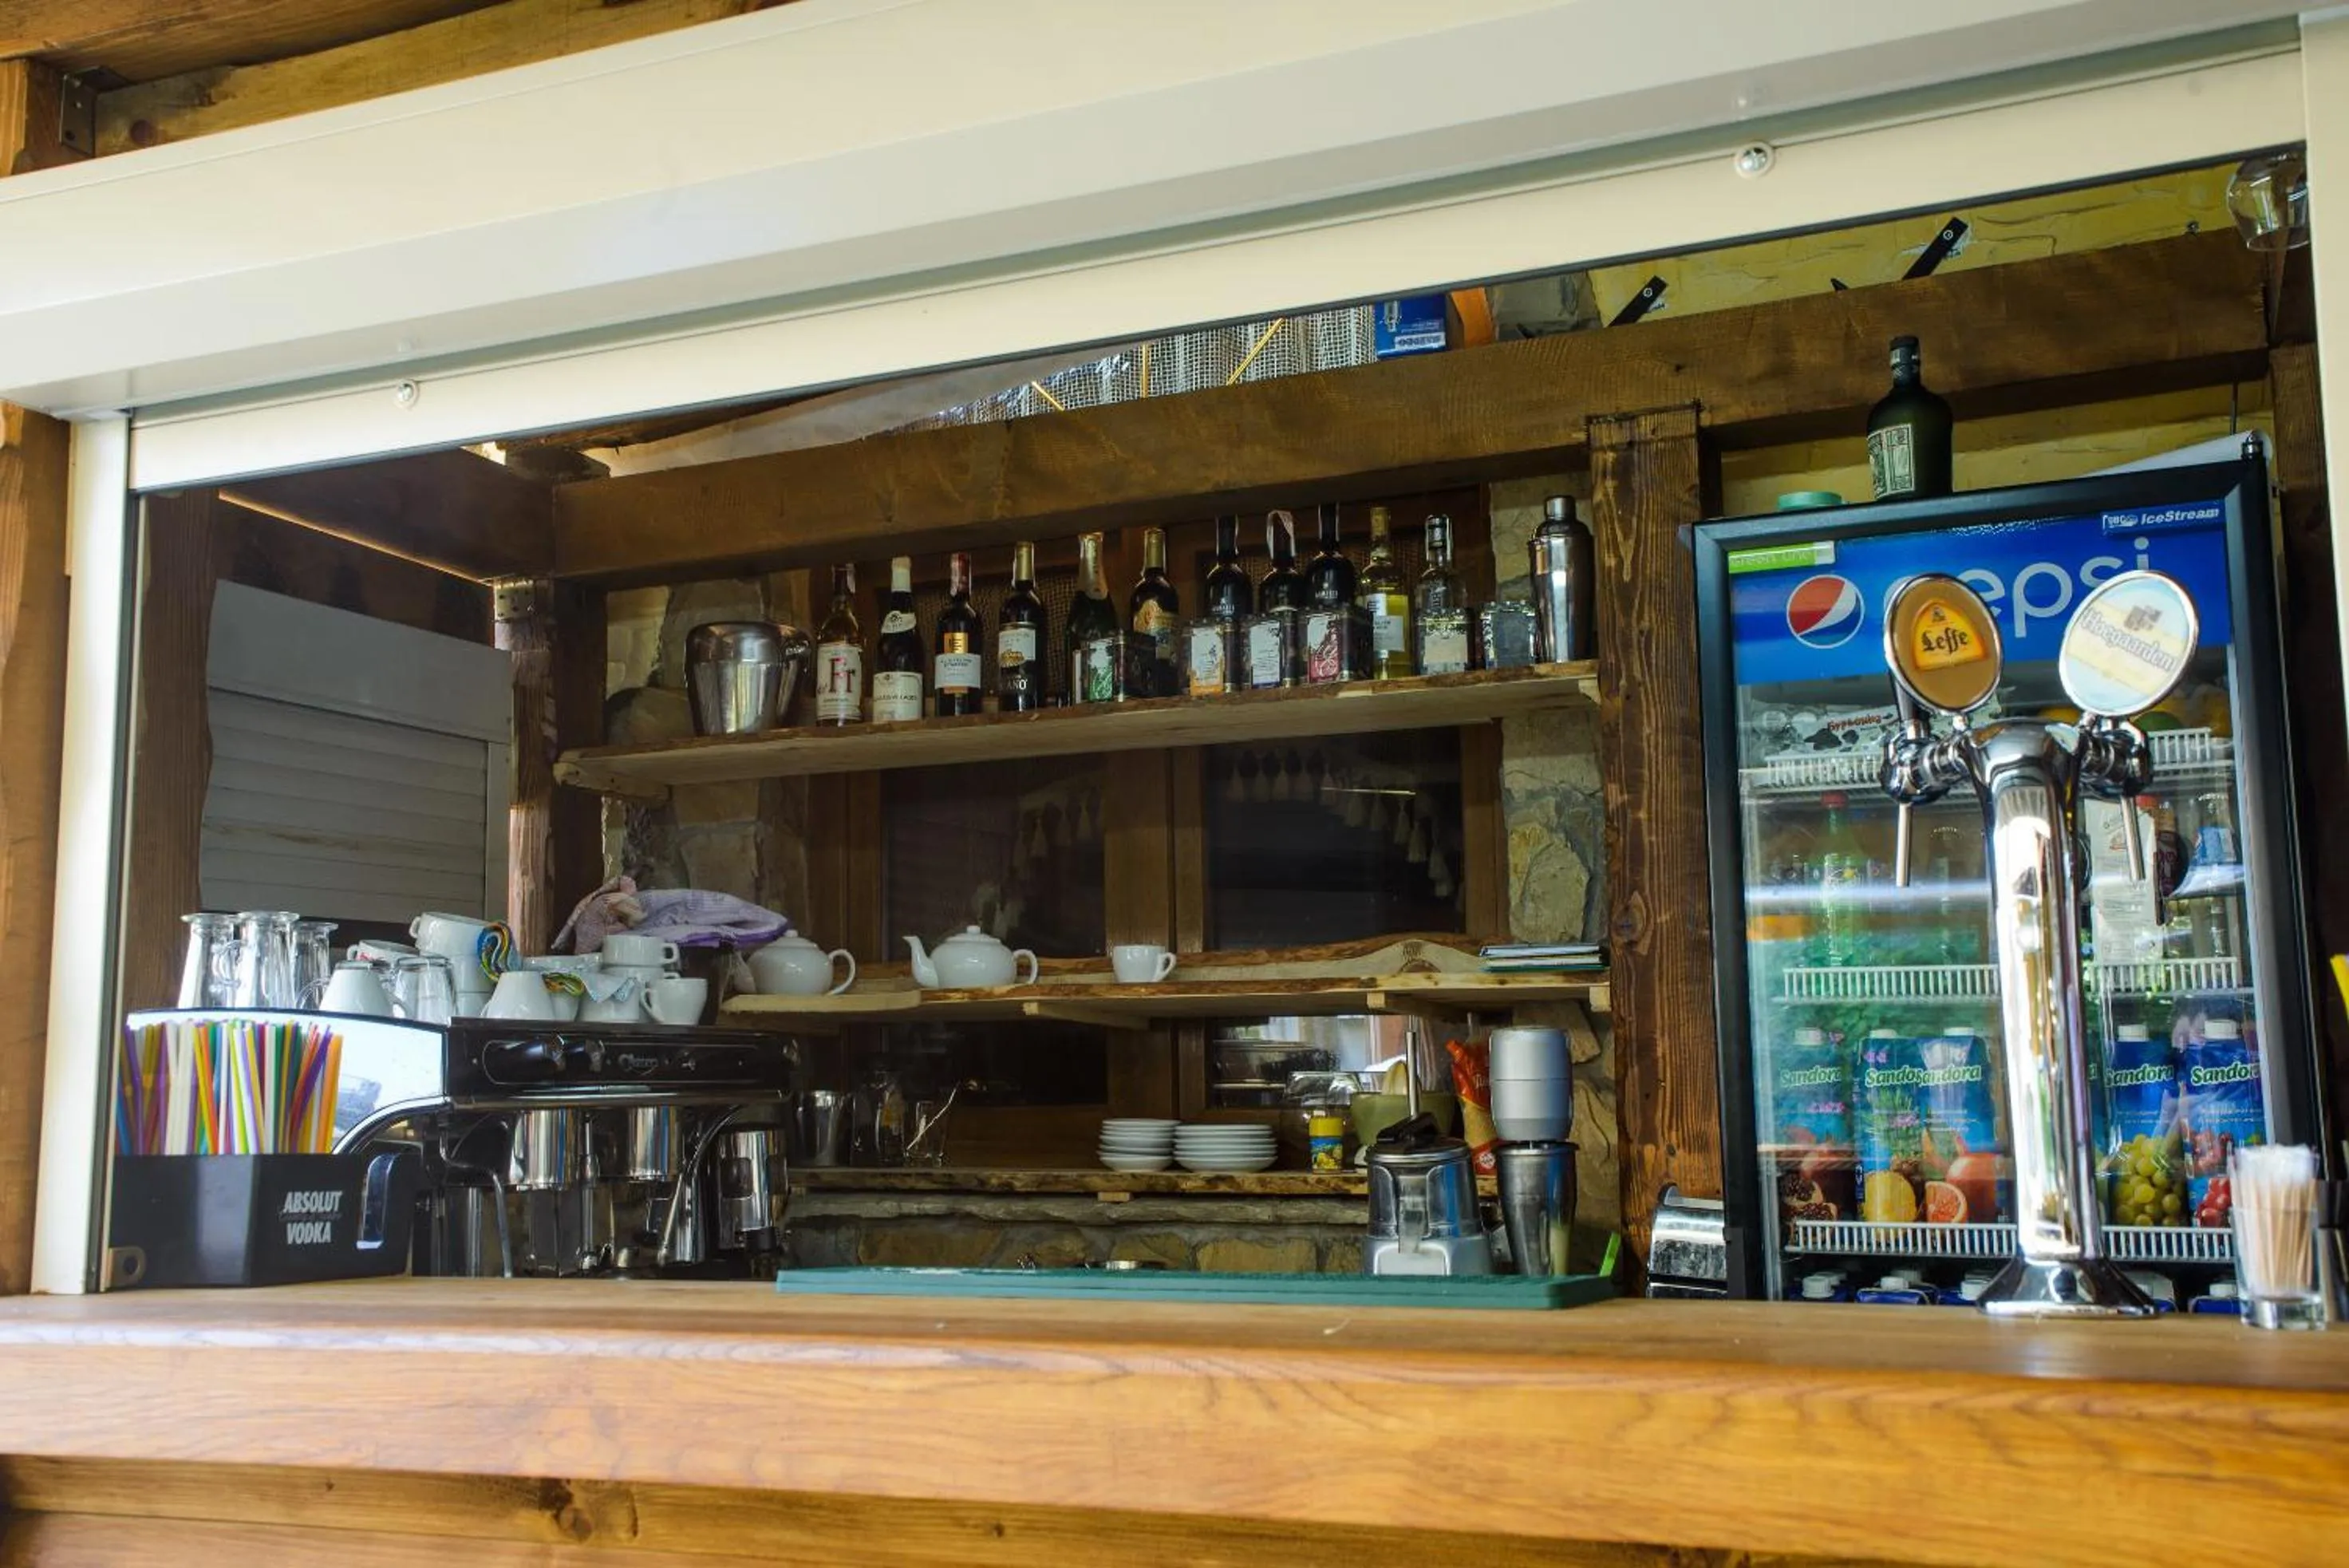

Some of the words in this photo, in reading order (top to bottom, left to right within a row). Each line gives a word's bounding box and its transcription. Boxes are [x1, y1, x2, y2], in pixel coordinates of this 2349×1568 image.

[2141, 508, 2221, 525] IceStream
[1921, 626, 1968, 654] Leffe
[2080, 607, 2179, 672] Hoegaarden
[1865, 1064, 1917, 1088] Sando
[282, 1191, 342, 1213] ABSOLUT
[287, 1221, 331, 1245] VODKA
